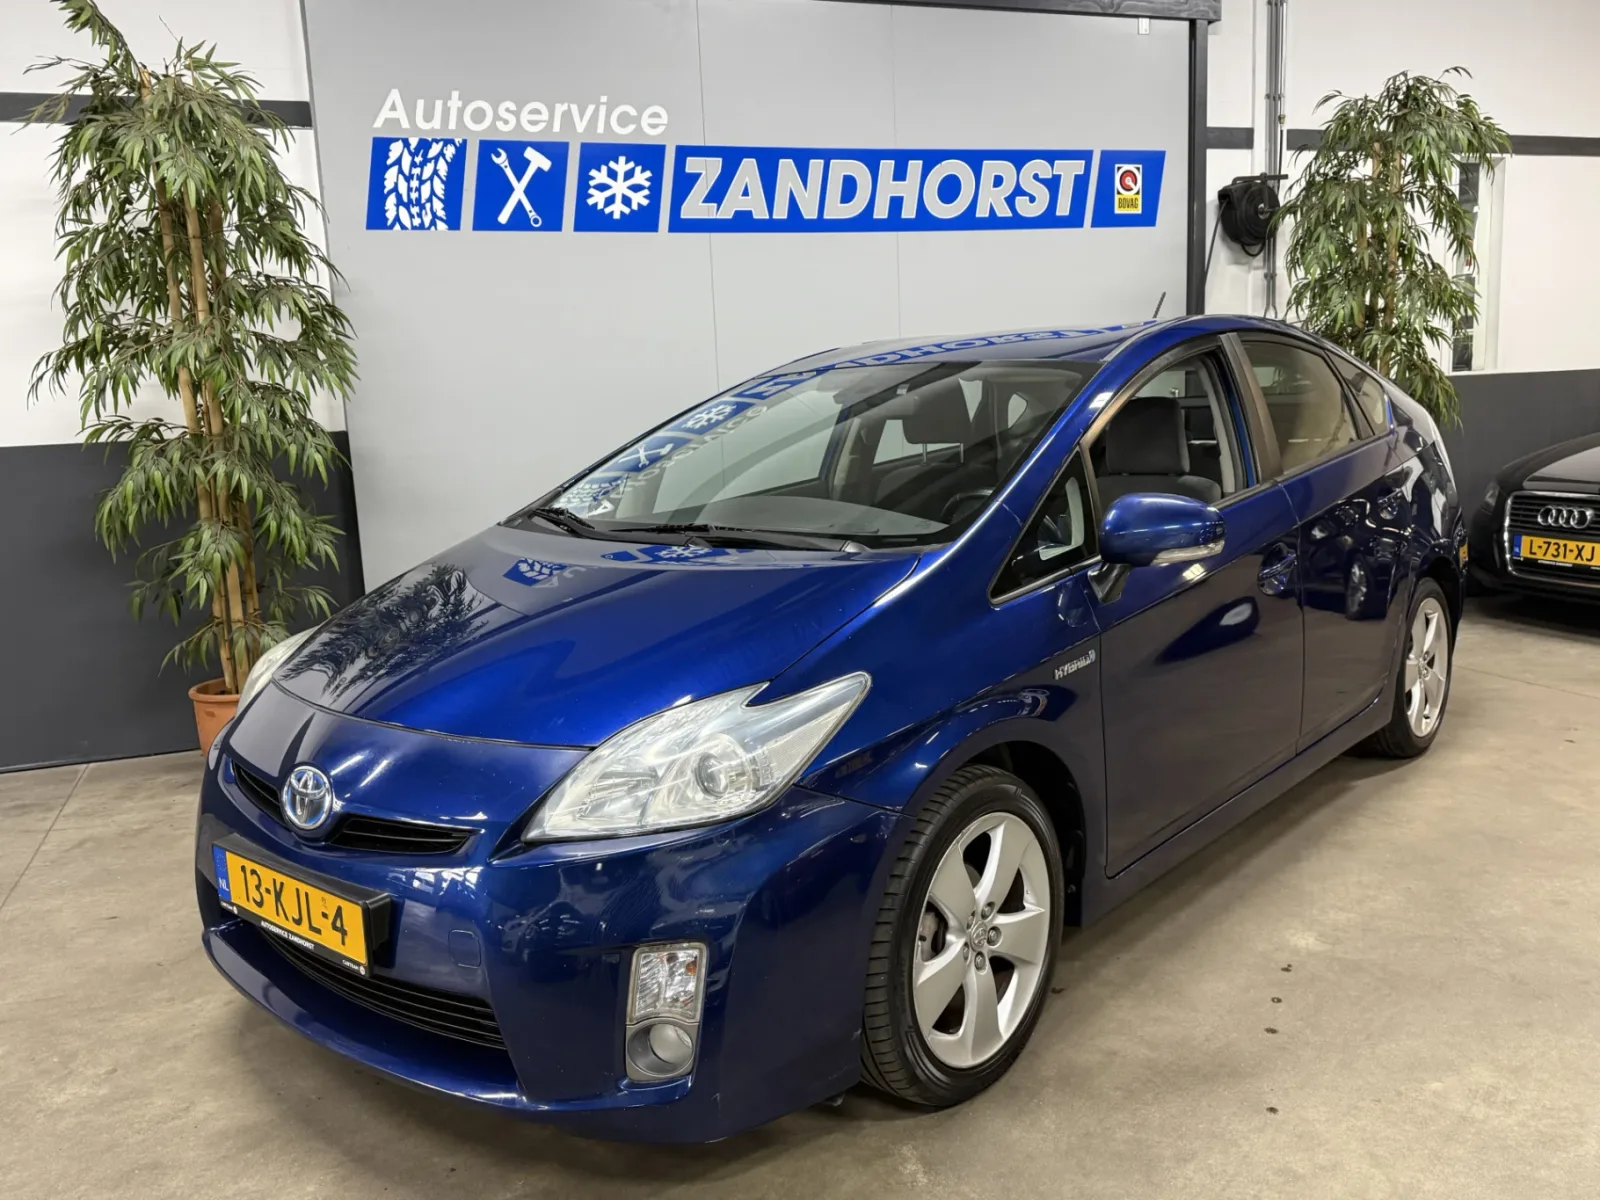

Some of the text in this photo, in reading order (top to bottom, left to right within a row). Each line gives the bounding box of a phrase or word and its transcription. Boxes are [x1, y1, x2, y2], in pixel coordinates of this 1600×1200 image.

[372, 88, 668, 136] Autoservice
[680, 157, 1086, 219] ZANDHORST
[1117, 197, 1139, 210] BOVAG
[1529, 539, 1595, 562] L-731-XJ
[218, 877, 229, 892] NL
[240, 864, 348, 946] 13-KJL-4
[261, 920, 315, 951] AUTOSERVICE ZANDHORST
